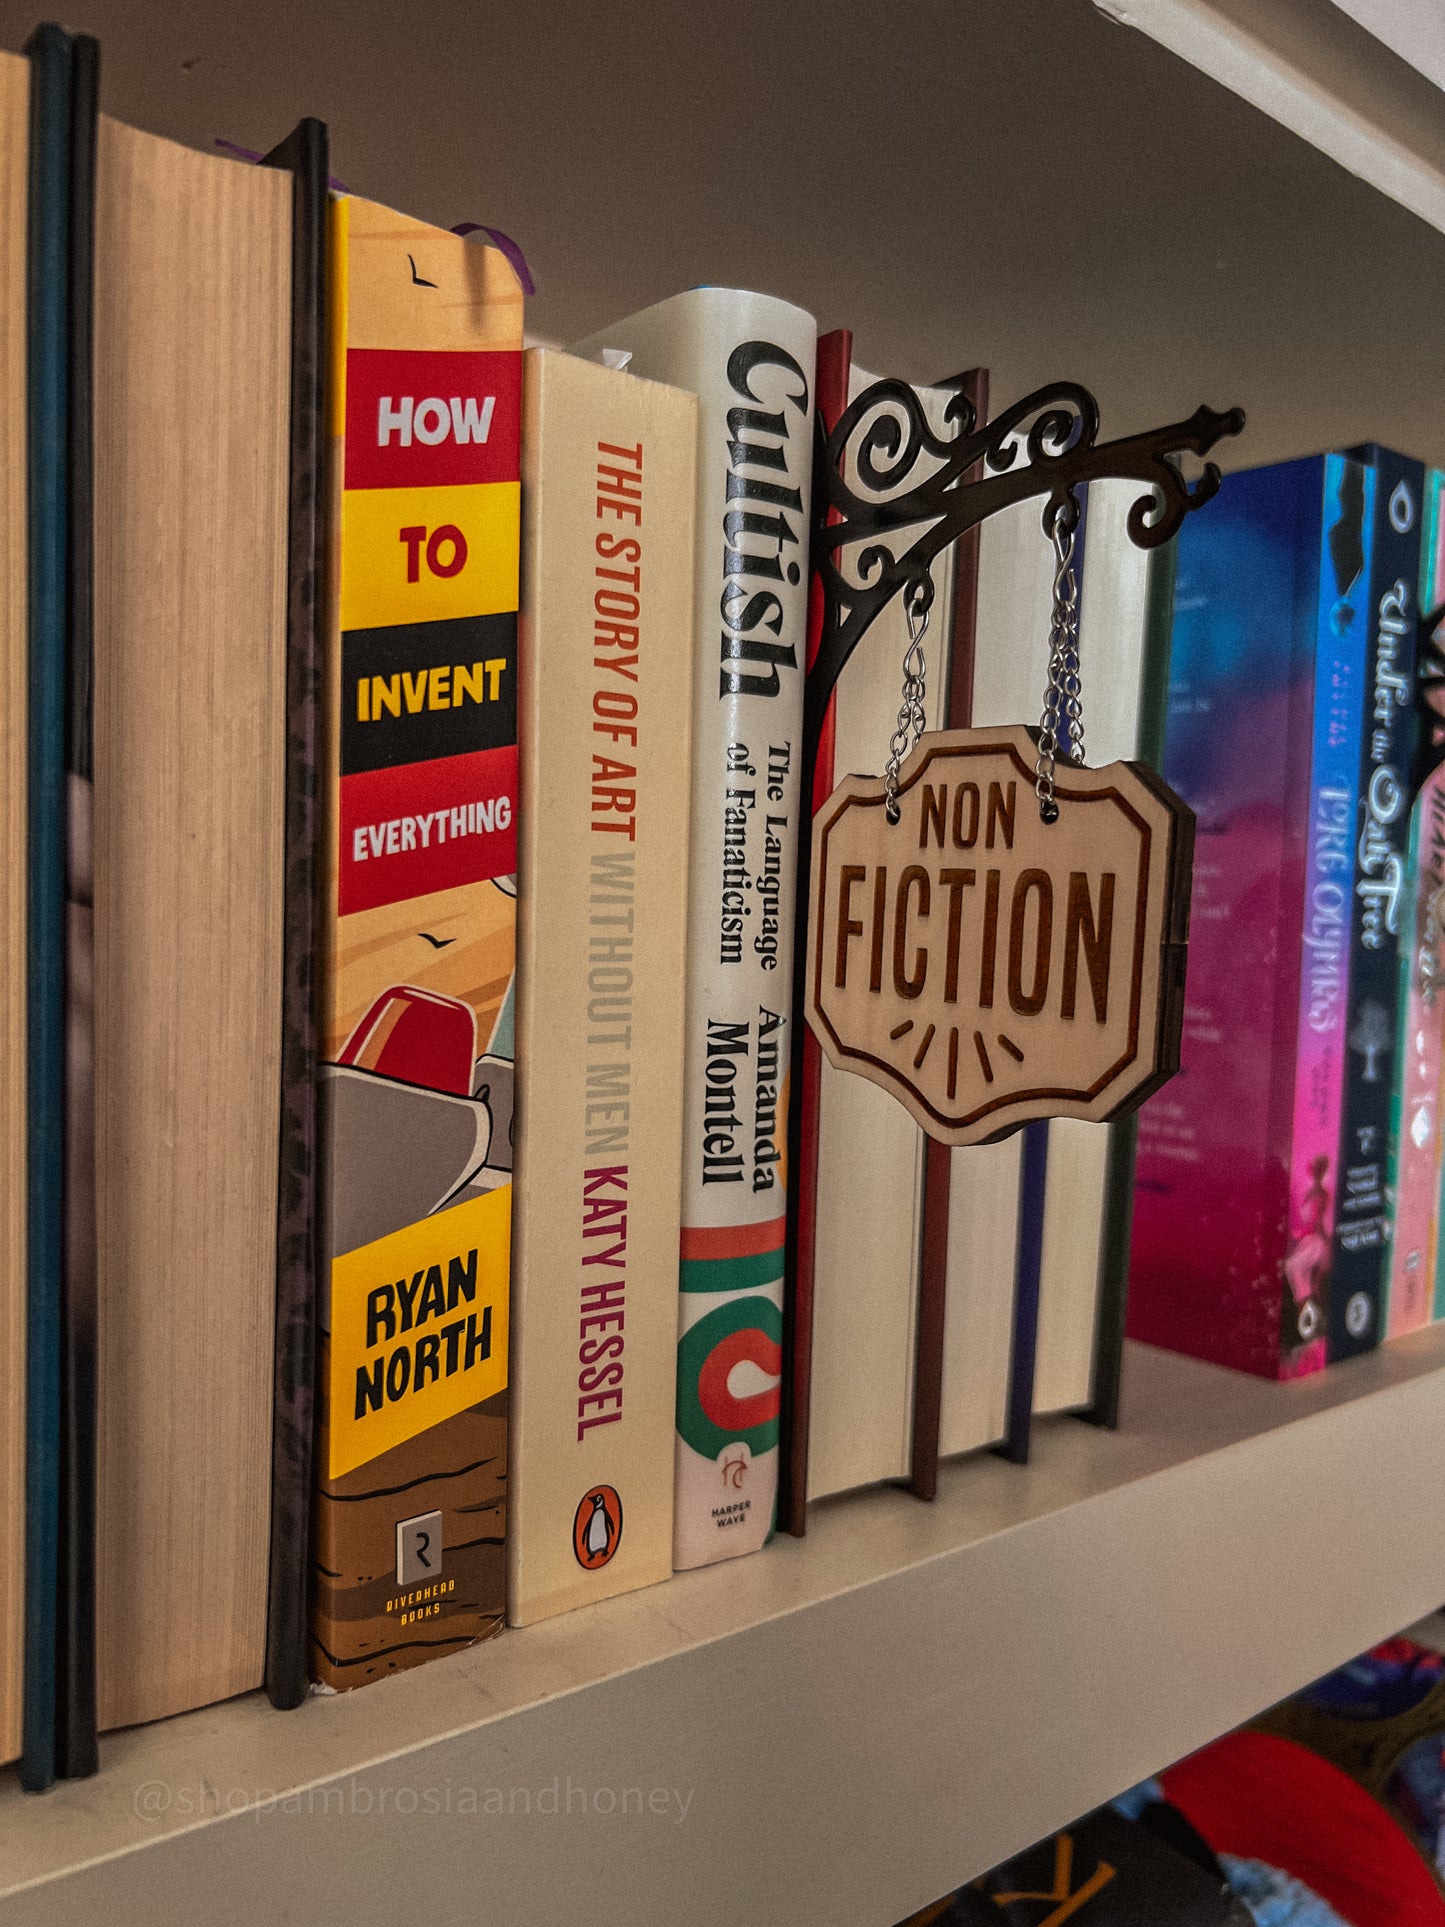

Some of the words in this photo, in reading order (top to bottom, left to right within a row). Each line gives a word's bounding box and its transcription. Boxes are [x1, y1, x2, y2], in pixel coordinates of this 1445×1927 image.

[378, 397, 496, 447] HOW
[596, 442, 642, 526] THE
[719, 340, 809, 701] Cultish
[400, 524, 468, 583] TO
[594, 533, 642, 682] STORY
[356, 658, 506, 722] INVENT
[592, 693, 639, 747] OF
[590, 755, 637, 841] ART
[727, 742, 756, 777] of
[767, 741, 791, 802] The
[353, 795, 511, 862] EVERYTHING
[919, 781, 1016, 849] NON
[720, 788, 756, 965] Fanaticism
[754, 814, 788, 971] Language
[587, 852, 635, 1050] WITHOUT
[835, 865, 1116, 1024] FICTION
[584, 1063, 631, 1154] MEN
[702, 1018, 749, 1186] Montell
[752, 1004, 787, 1193] Amanda
[581, 1165, 628, 1268] KATY
[365, 1248, 478, 1349] RYAN
[354, 1305, 493, 1421] NORTH
[577, 1280, 625, 1442] HESSEL
[712, 1500, 751, 1517] HARPER
[717, 1513, 745, 1527] WAVE
[386, 1579, 455, 1612] RIVERHEAD
[401, 1602, 440, 1625] BOOKS
